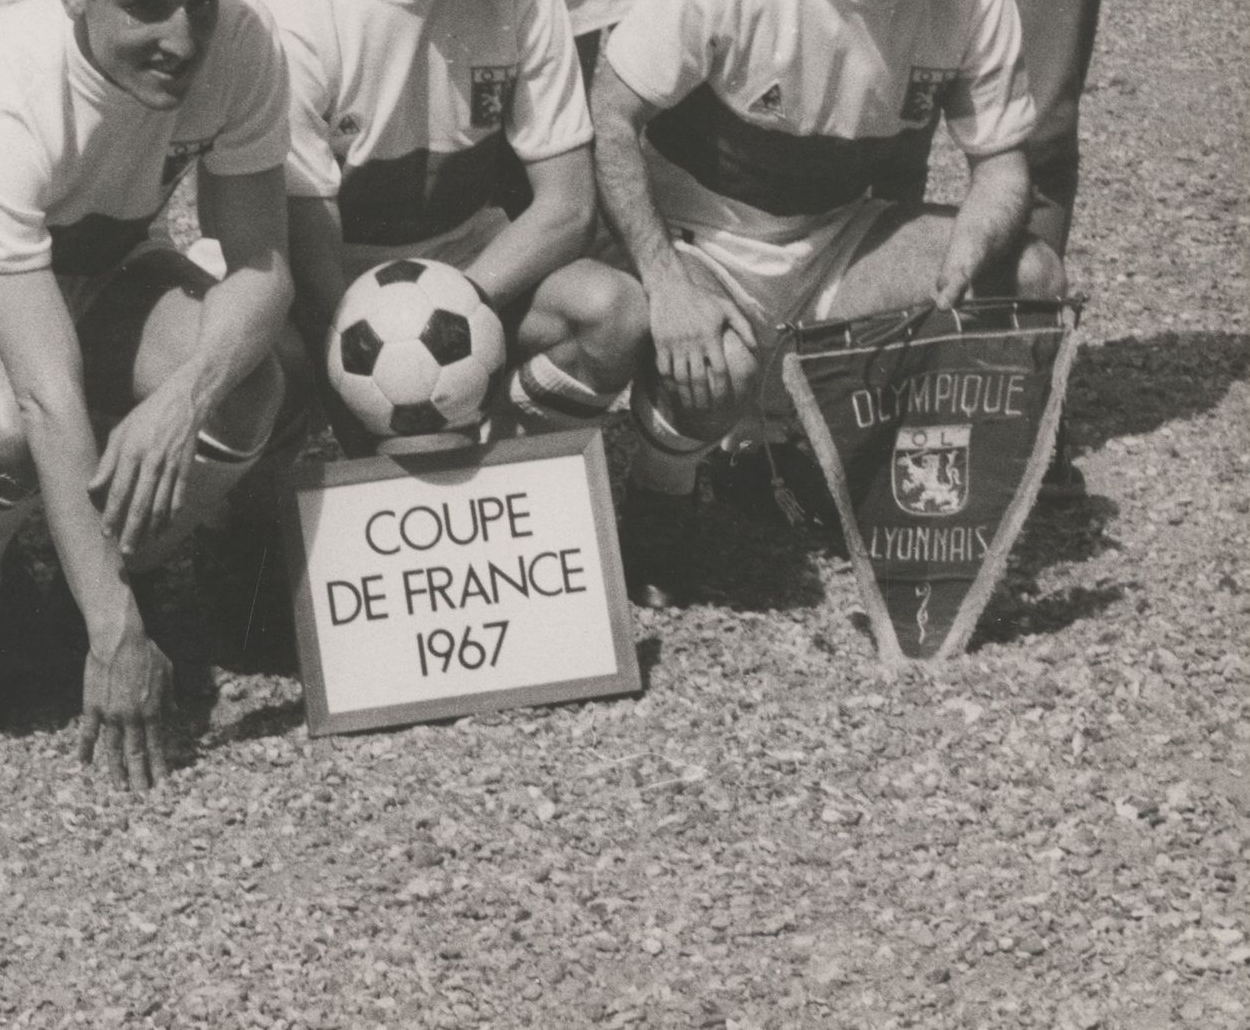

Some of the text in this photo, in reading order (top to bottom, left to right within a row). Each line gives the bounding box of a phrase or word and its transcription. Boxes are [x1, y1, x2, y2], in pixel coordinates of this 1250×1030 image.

[852, 374, 1025, 428] OLYMPIQUE
[365, 492, 533, 555] COUPE
[870, 526, 989, 562] LYONNAIS
[326, 548, 587, 626] DE FRANCE
[416, 620, 510, 676] 1967
